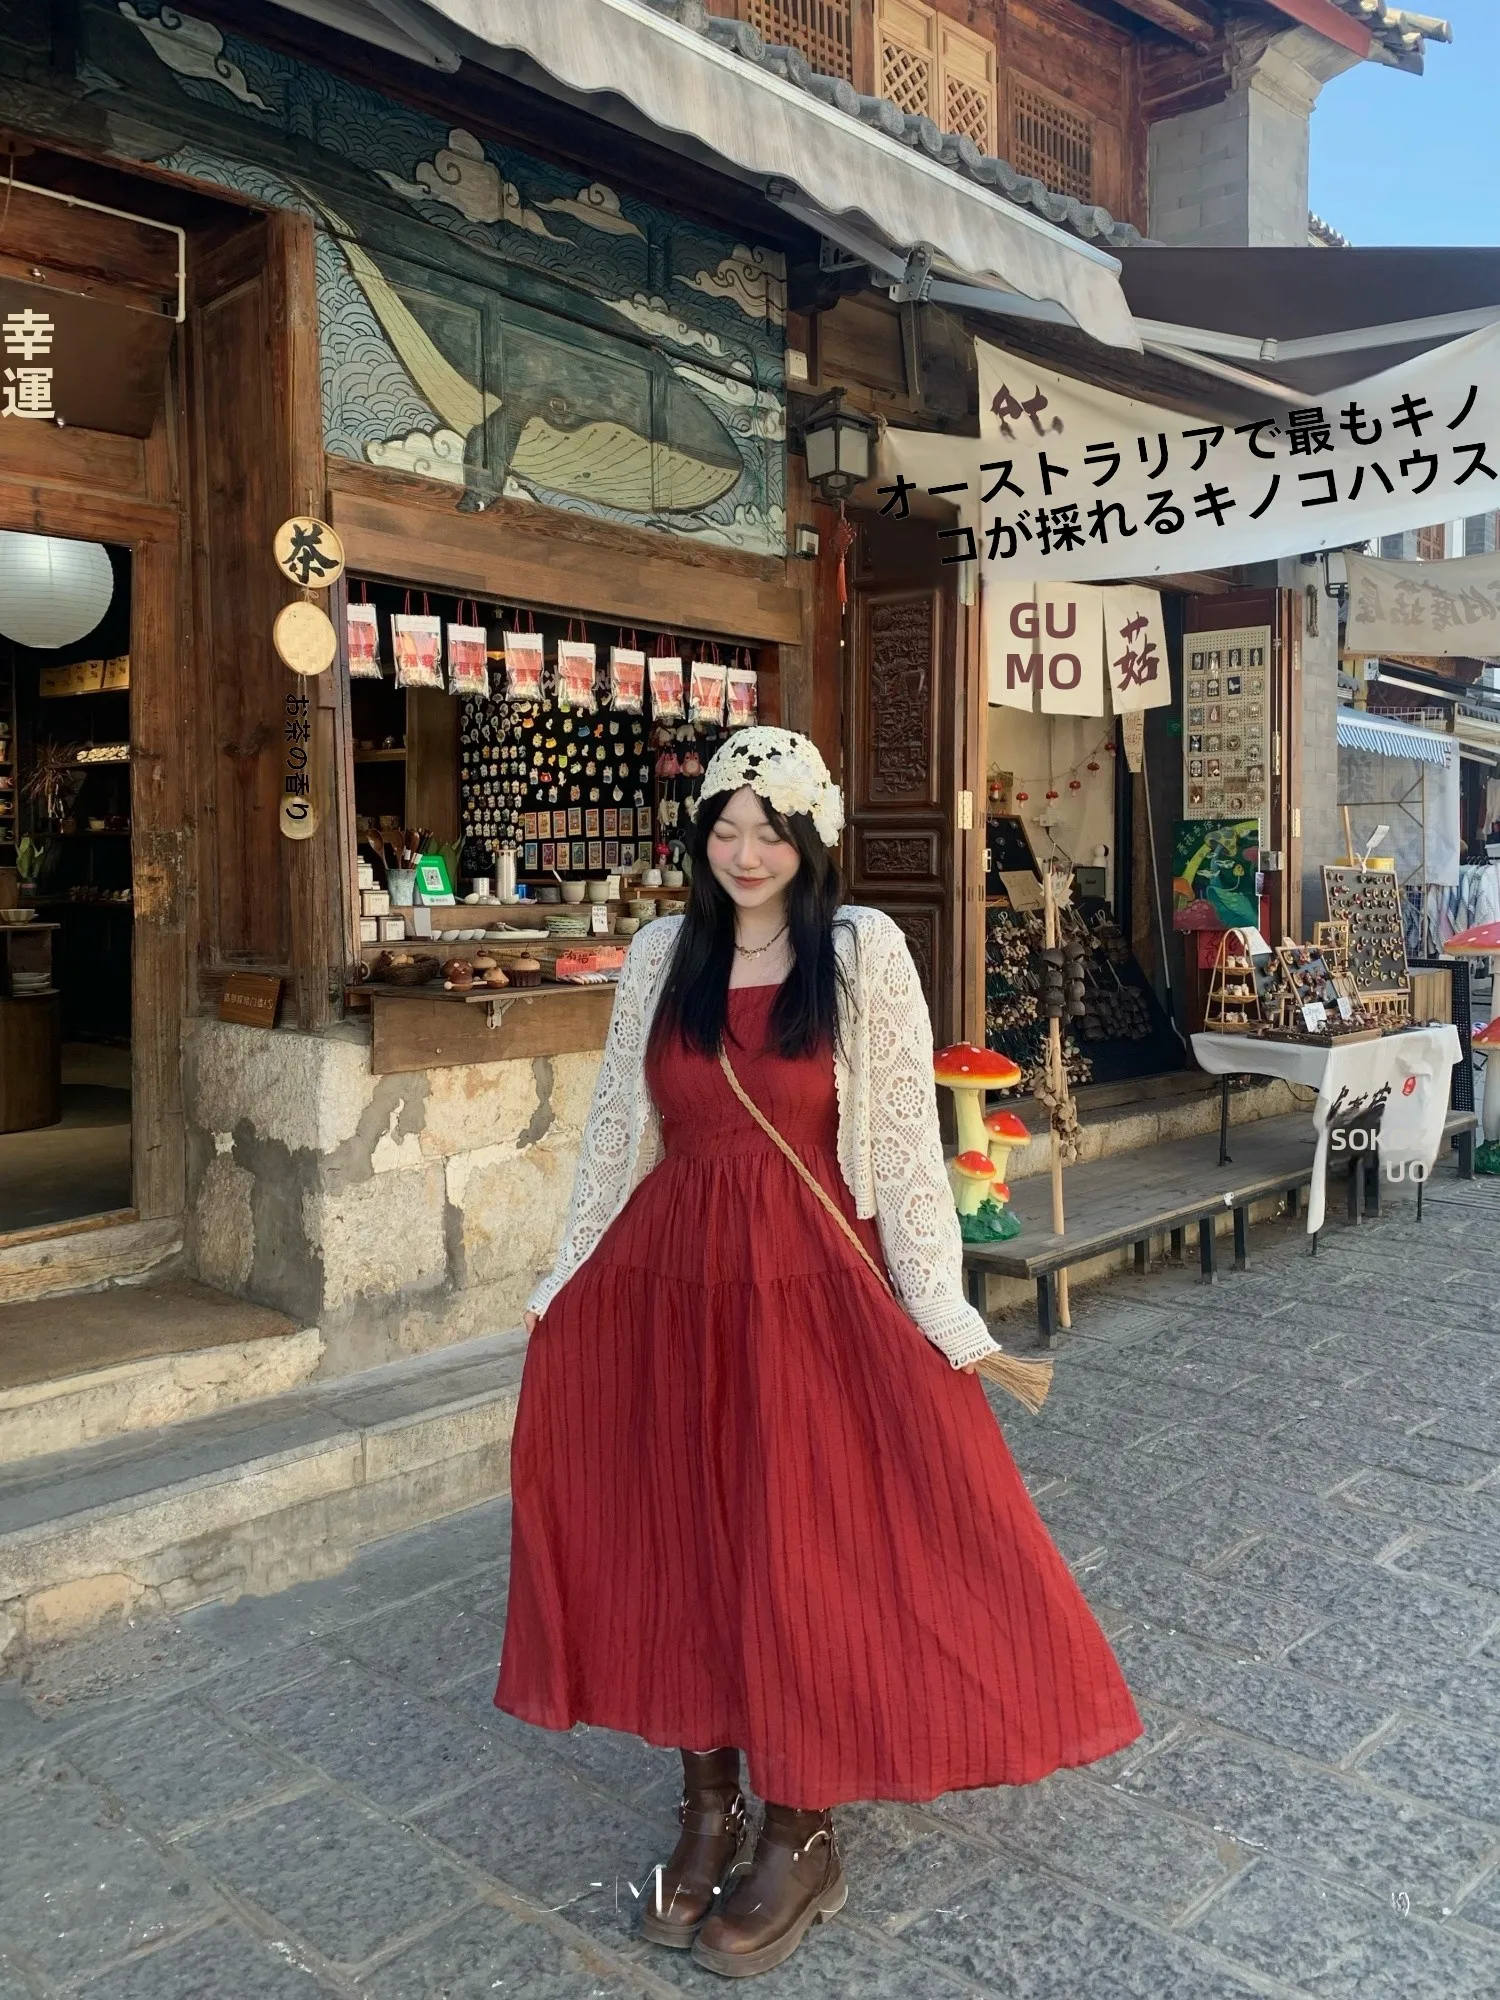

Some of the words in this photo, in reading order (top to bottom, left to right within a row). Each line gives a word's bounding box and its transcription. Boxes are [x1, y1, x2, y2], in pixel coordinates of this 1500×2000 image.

[1, 308, 55, 418] 幸運
[876, 384, 1478, 520] オーストラリアで最もキノ
[937, 442, 1498, 566] コが採れるキノコハウス
[281, 523, 340, 584] 茶
[1006, 653, 1082, 690] MO
[1009, 602, 1077, 639] GU
[284, 694, 311, 820] お茶の香り
